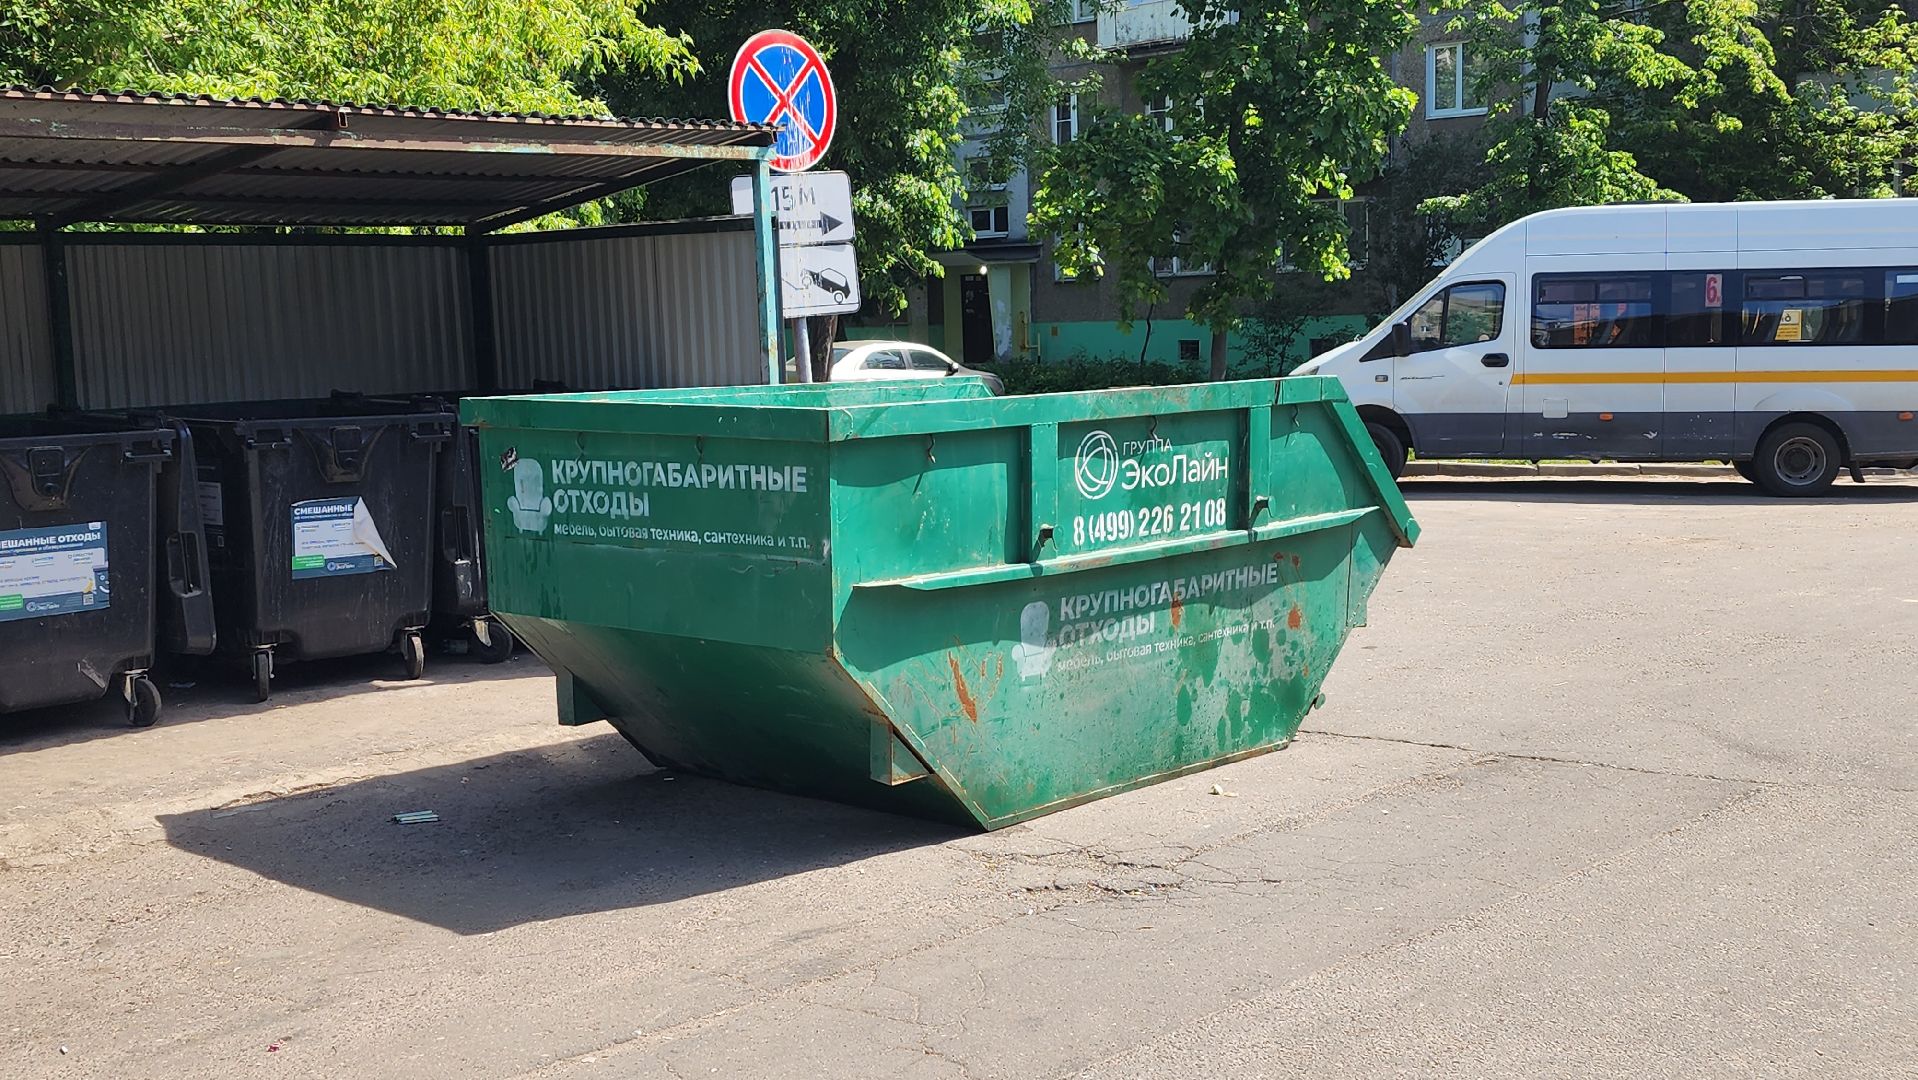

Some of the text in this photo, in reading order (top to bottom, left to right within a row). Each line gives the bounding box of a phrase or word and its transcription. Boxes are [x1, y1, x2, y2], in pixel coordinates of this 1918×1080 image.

[1122, 437, 1173, 457] ГРУППА
[552, 459, 808, 493] КРУПНОГАБАРИТНЫЕ
[1121, 453, 1229, 490] ЭкоЛайн
[294, 504, 353, 516] СМЕШАННЫЕ
[552, 489, 650, 520] ОТХОДЫ
[58, 532, 101, 543] ОТХОДЫ
[650, 528, 702, 544] техника,
[704, 531, 774, 547] сантехника
[778, 535, 786, 547] и
[789, 536, 811, 549] т.п.
[1073, 515, 1085, 546] 8
[1089, 509, 1135, 543] (499)
[1138, 507, 1174, 537] 226
[1059, 562, 1278, 622] КРУПНОГАБАРИТНЫЕ
[1058, 611, 1155, 649] ОТХОДЫ
[1153, 635, 1196, 653] техника,
[1199, 622, 1250, 643] сантехника
